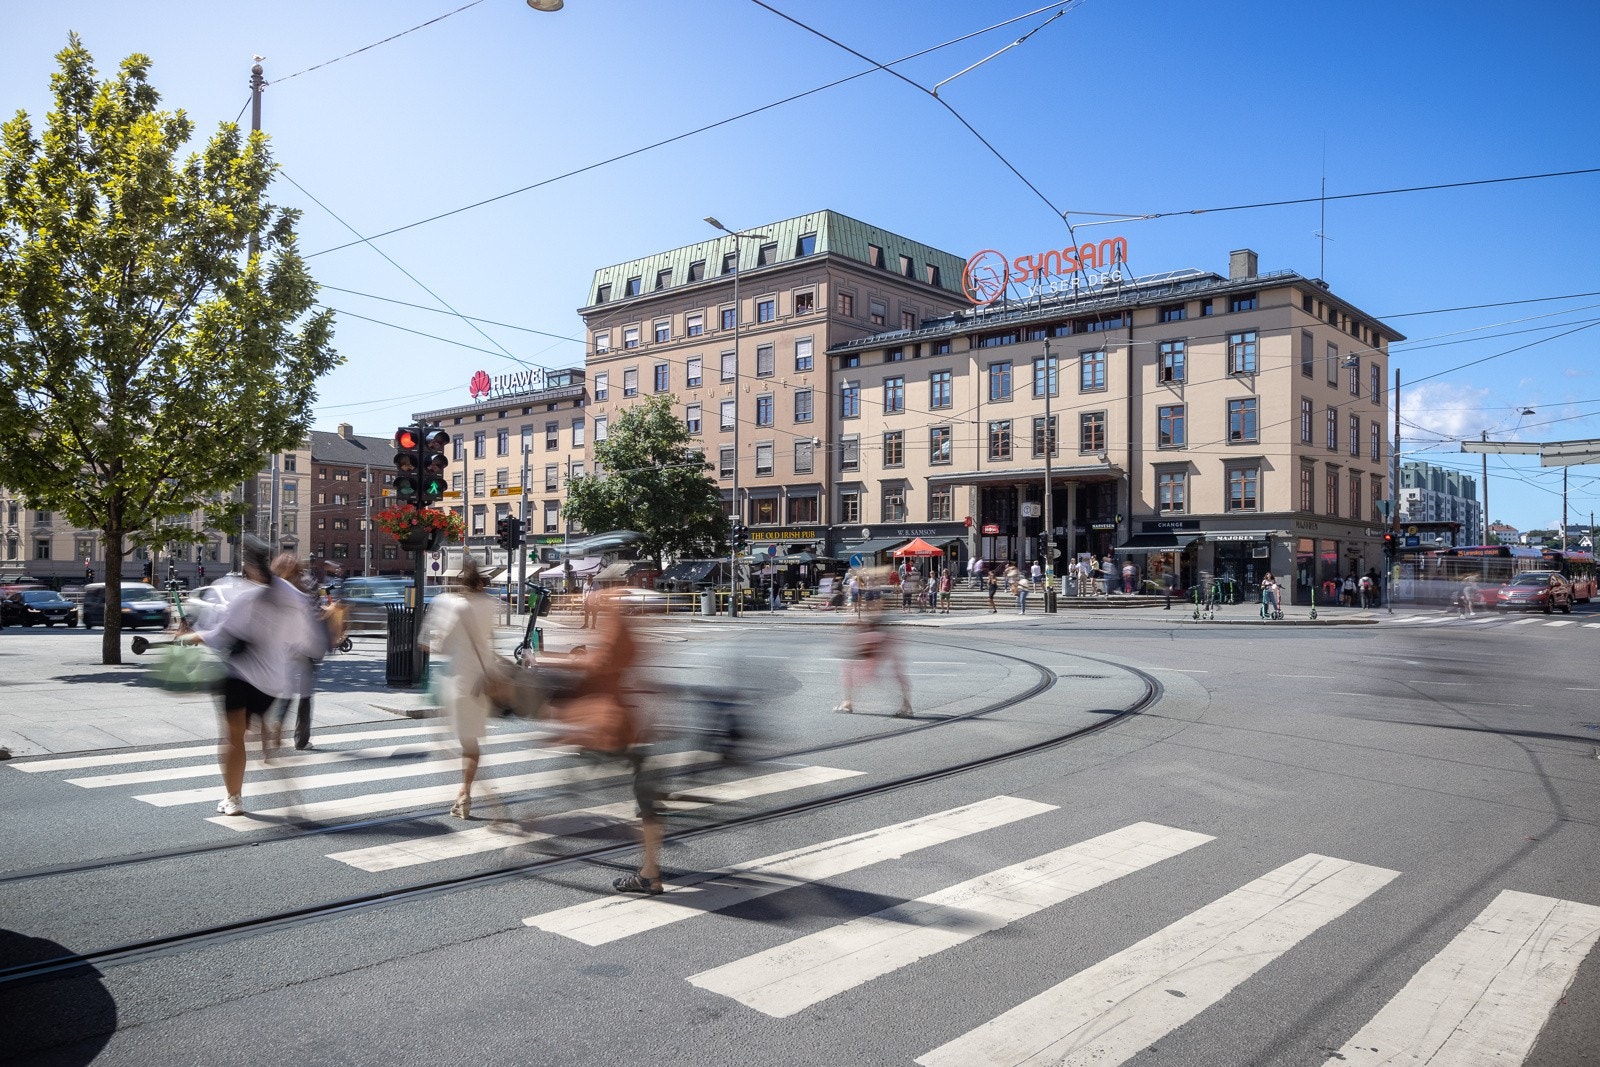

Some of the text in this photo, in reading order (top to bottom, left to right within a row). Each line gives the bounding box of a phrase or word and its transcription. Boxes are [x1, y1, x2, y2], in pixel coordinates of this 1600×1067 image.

[1013, 236, 1128, 283] SYNSAM
[1029, 269, 1122, 298] VI SER DEG
[493, 367, 544, 390] HUAWEI
[751, 532, 765, 540] THE
[765, 531, 780, 539] OLD
[781, 531, 800, 539] IRISH
